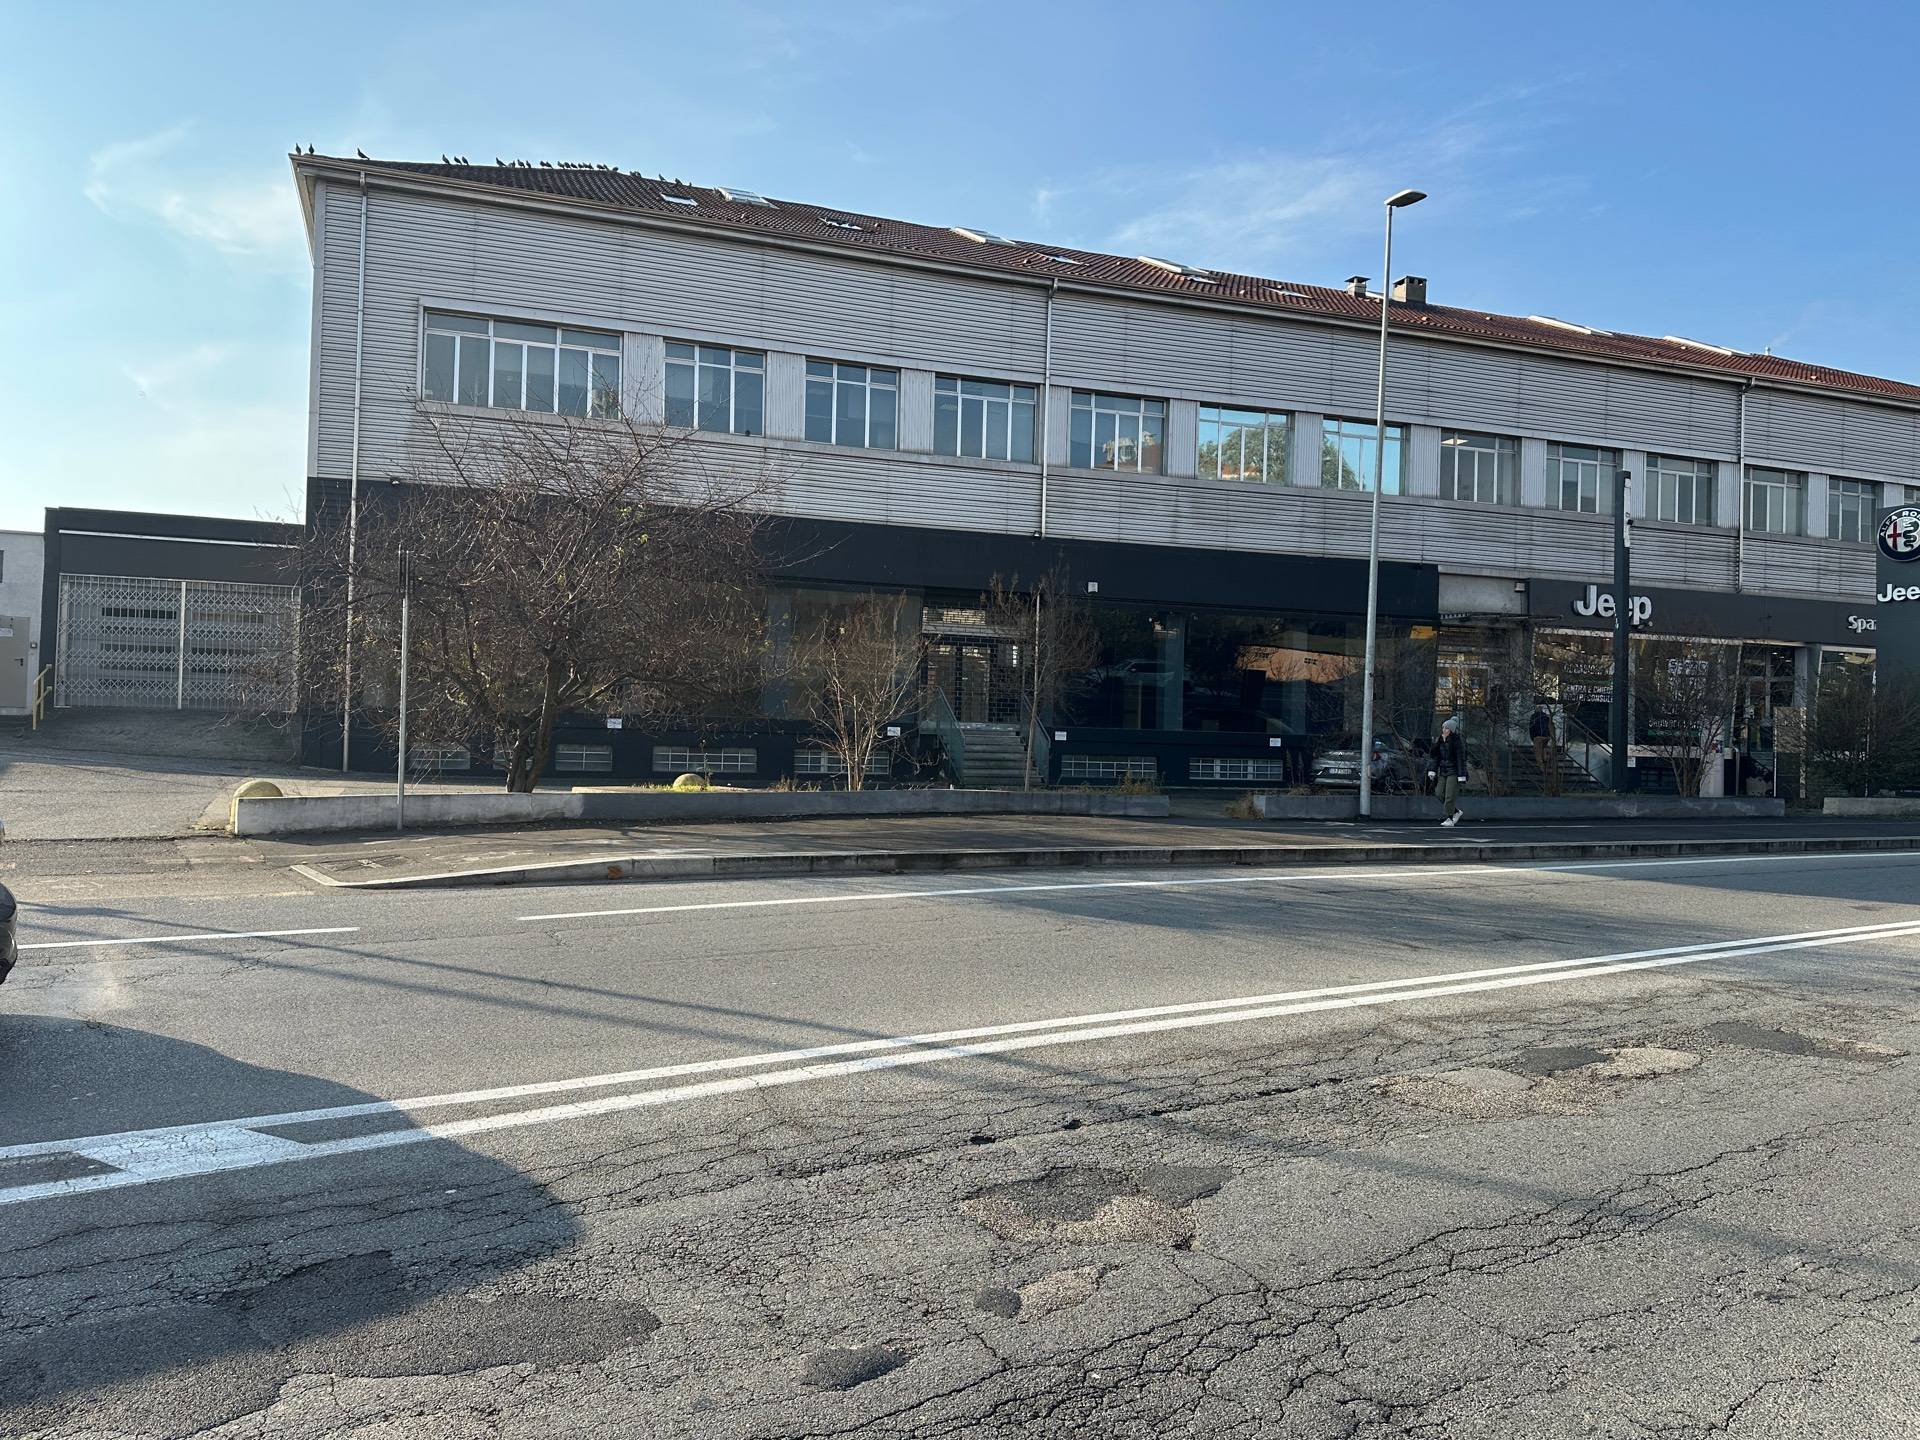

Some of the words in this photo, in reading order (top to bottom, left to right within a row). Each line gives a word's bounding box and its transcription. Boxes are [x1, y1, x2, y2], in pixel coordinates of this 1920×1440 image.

[1880, 515, 1898, 537] ALFA
[1574, 584, 1652, 625] Jep
[1586, 694, 1613, 703] CONSUL
